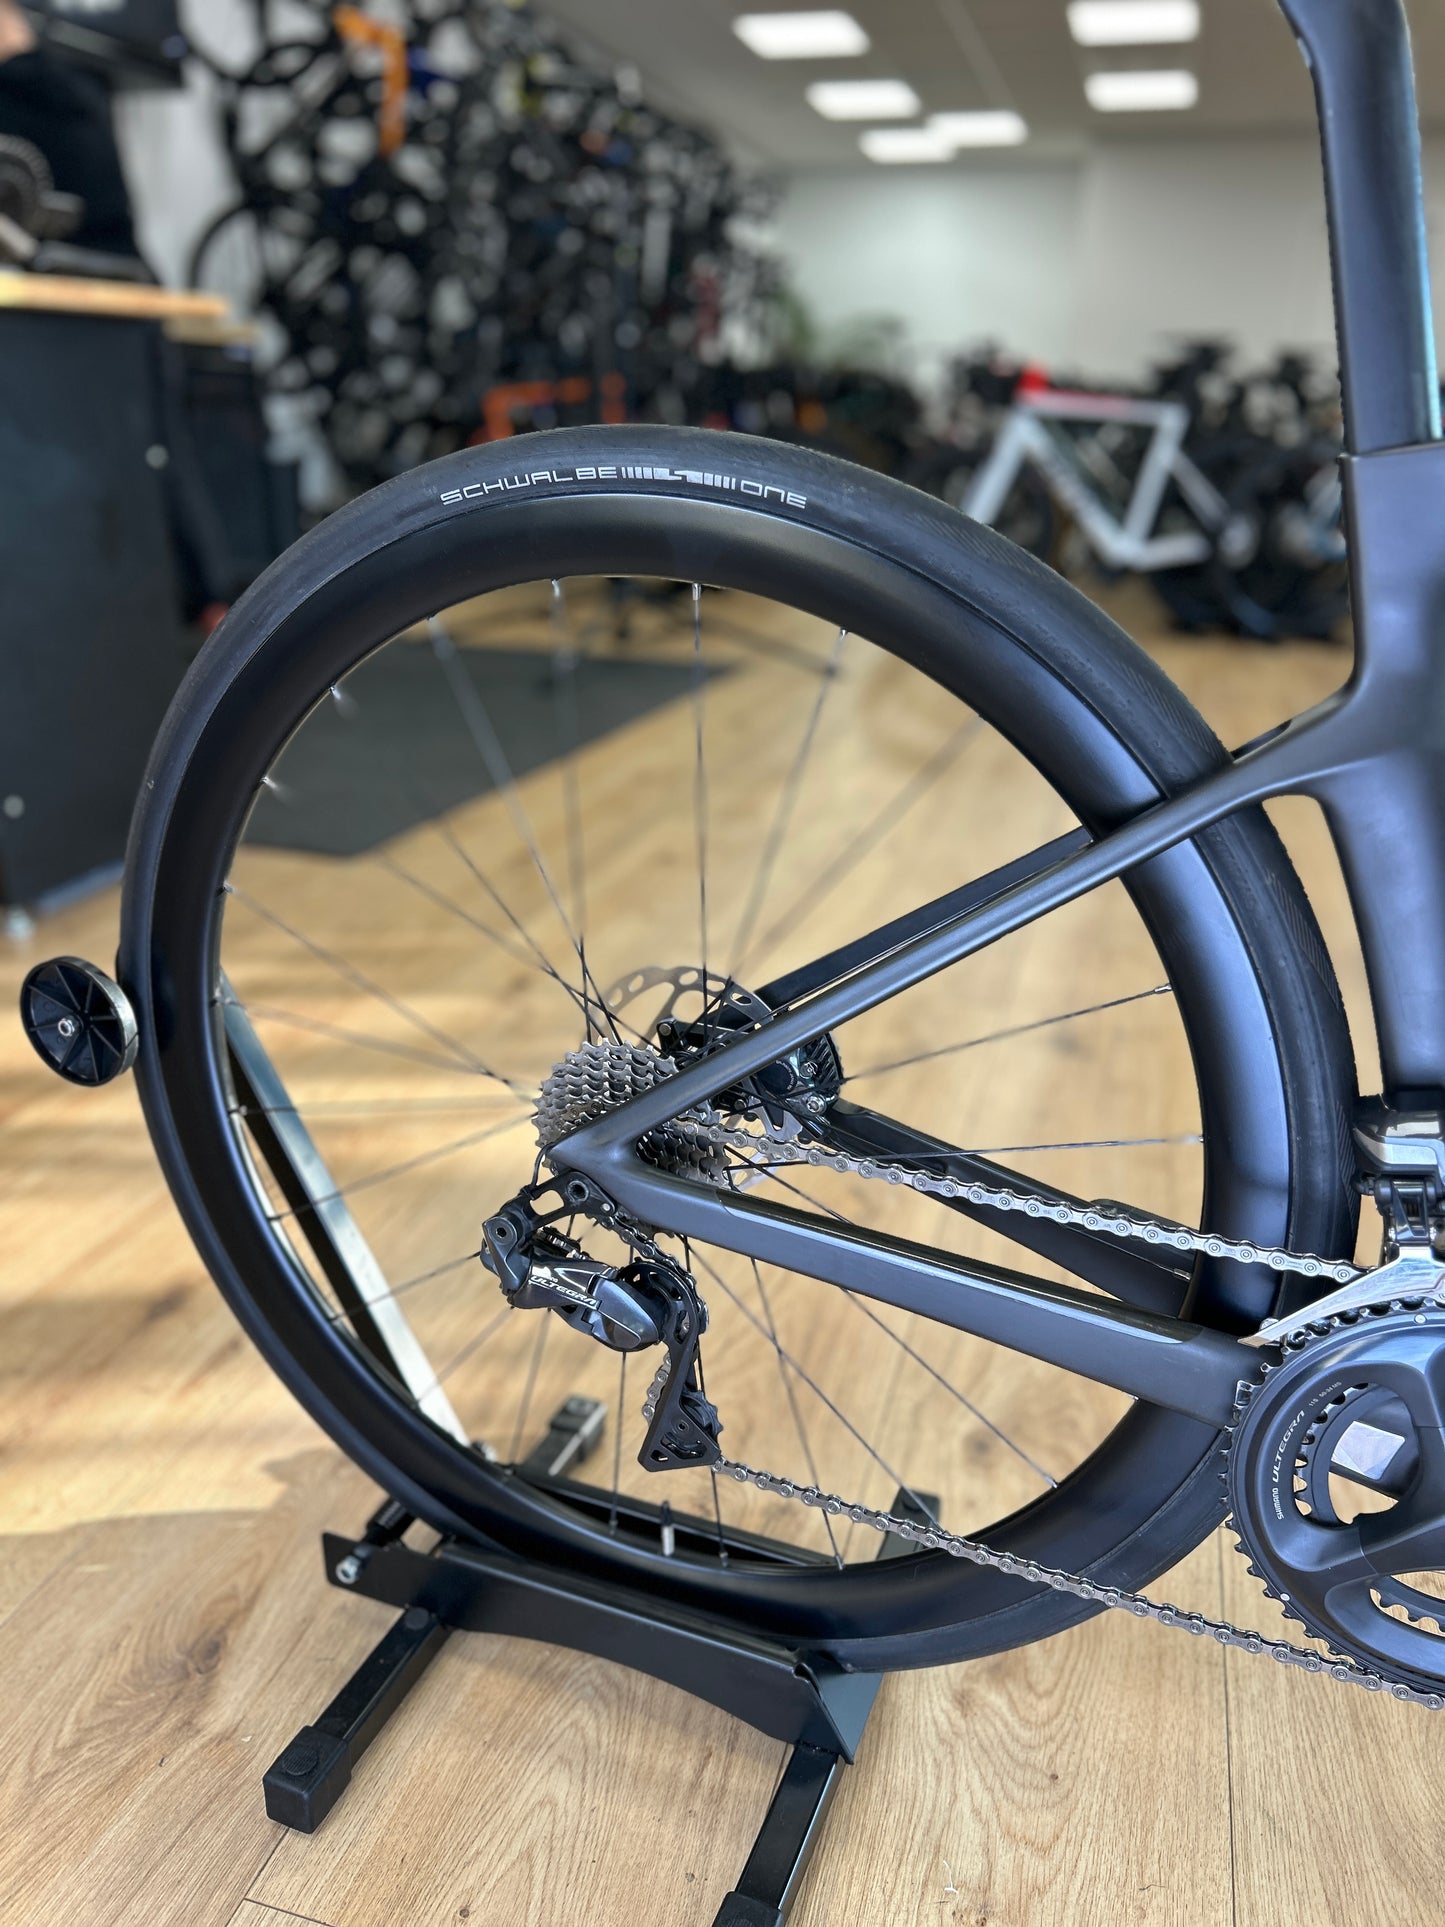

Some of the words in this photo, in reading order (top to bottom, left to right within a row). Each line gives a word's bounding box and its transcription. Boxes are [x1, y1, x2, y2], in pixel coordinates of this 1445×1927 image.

[440, 466, 618, 506] SCHWALBE
[530, 1275, 598, 1306] ULTEGRA
[1272, 1409, 1306, 1484] ULTEGRA
[1271, 1487, 1285, 1521] SHIMANO
